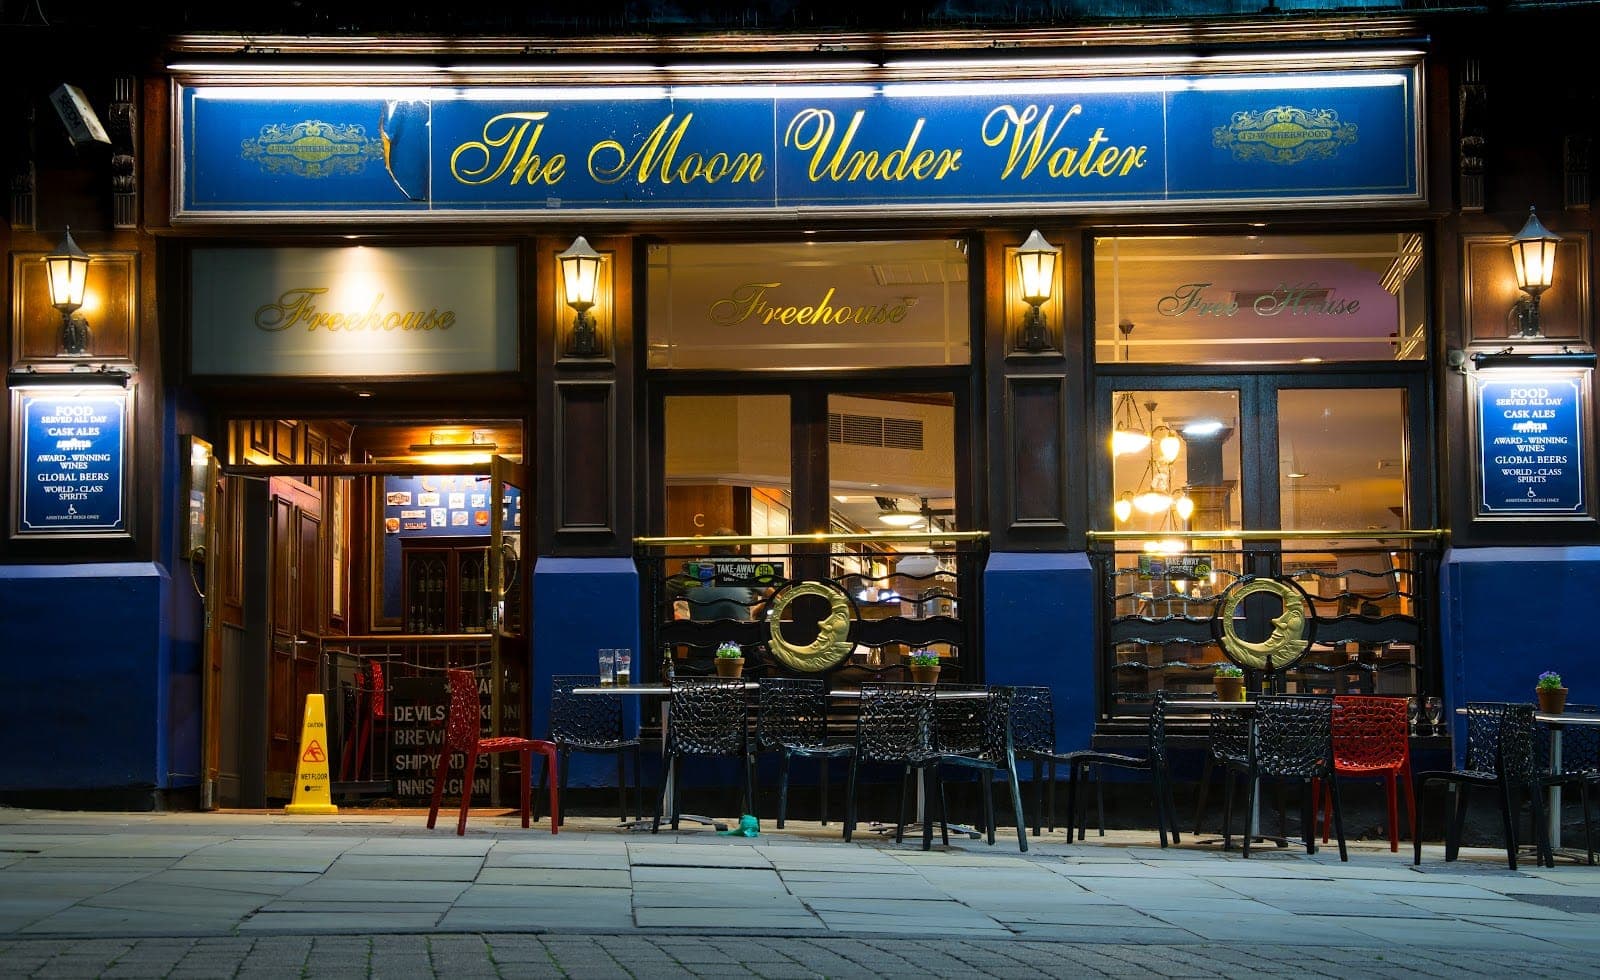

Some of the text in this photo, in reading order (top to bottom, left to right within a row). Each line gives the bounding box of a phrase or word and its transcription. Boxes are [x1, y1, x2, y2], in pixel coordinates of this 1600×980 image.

[450, 104, 1148, 185] The Moon Under Water
[1157, 281, 1361, 317] Free House
[707, 282, 908, 327] Freehouse
[254, 287, 456, 332] Freehouse
[1510, 388, 1549, 399] FOOD
[1496, 398, 1563, 406] SERVED ALL DAY
[55, 405, 94, 416] FOOD
[1503, 410, 1556, 419] CASK ALES
[41, 416, 72, 424] SERVED
[90, 415, 107, 423] DAY
[48, 427, 100, 436] CASK ALES
[1493, 437, 1523, 445] AWARD
[1516, 444, 1545, 452] WINES
[72, 454, 111, 462] WINNING
[1495, 456, 1568, 464] GLOBAL BEERS
[60, 462, 88, 470] WINES
[1501, 468, 1532, 476] WORLD
[37, 473, 110, 482] GLOBAL BEERS
[1517, 475, 1547, 483] SPIRITS
[79, 485, 104, 493] CLASS
[716, 564, 756, 574] TAKE-AWAY
[394, 705, 446, 722] DEVILS
[397, 779, 434, 796] INNIS
